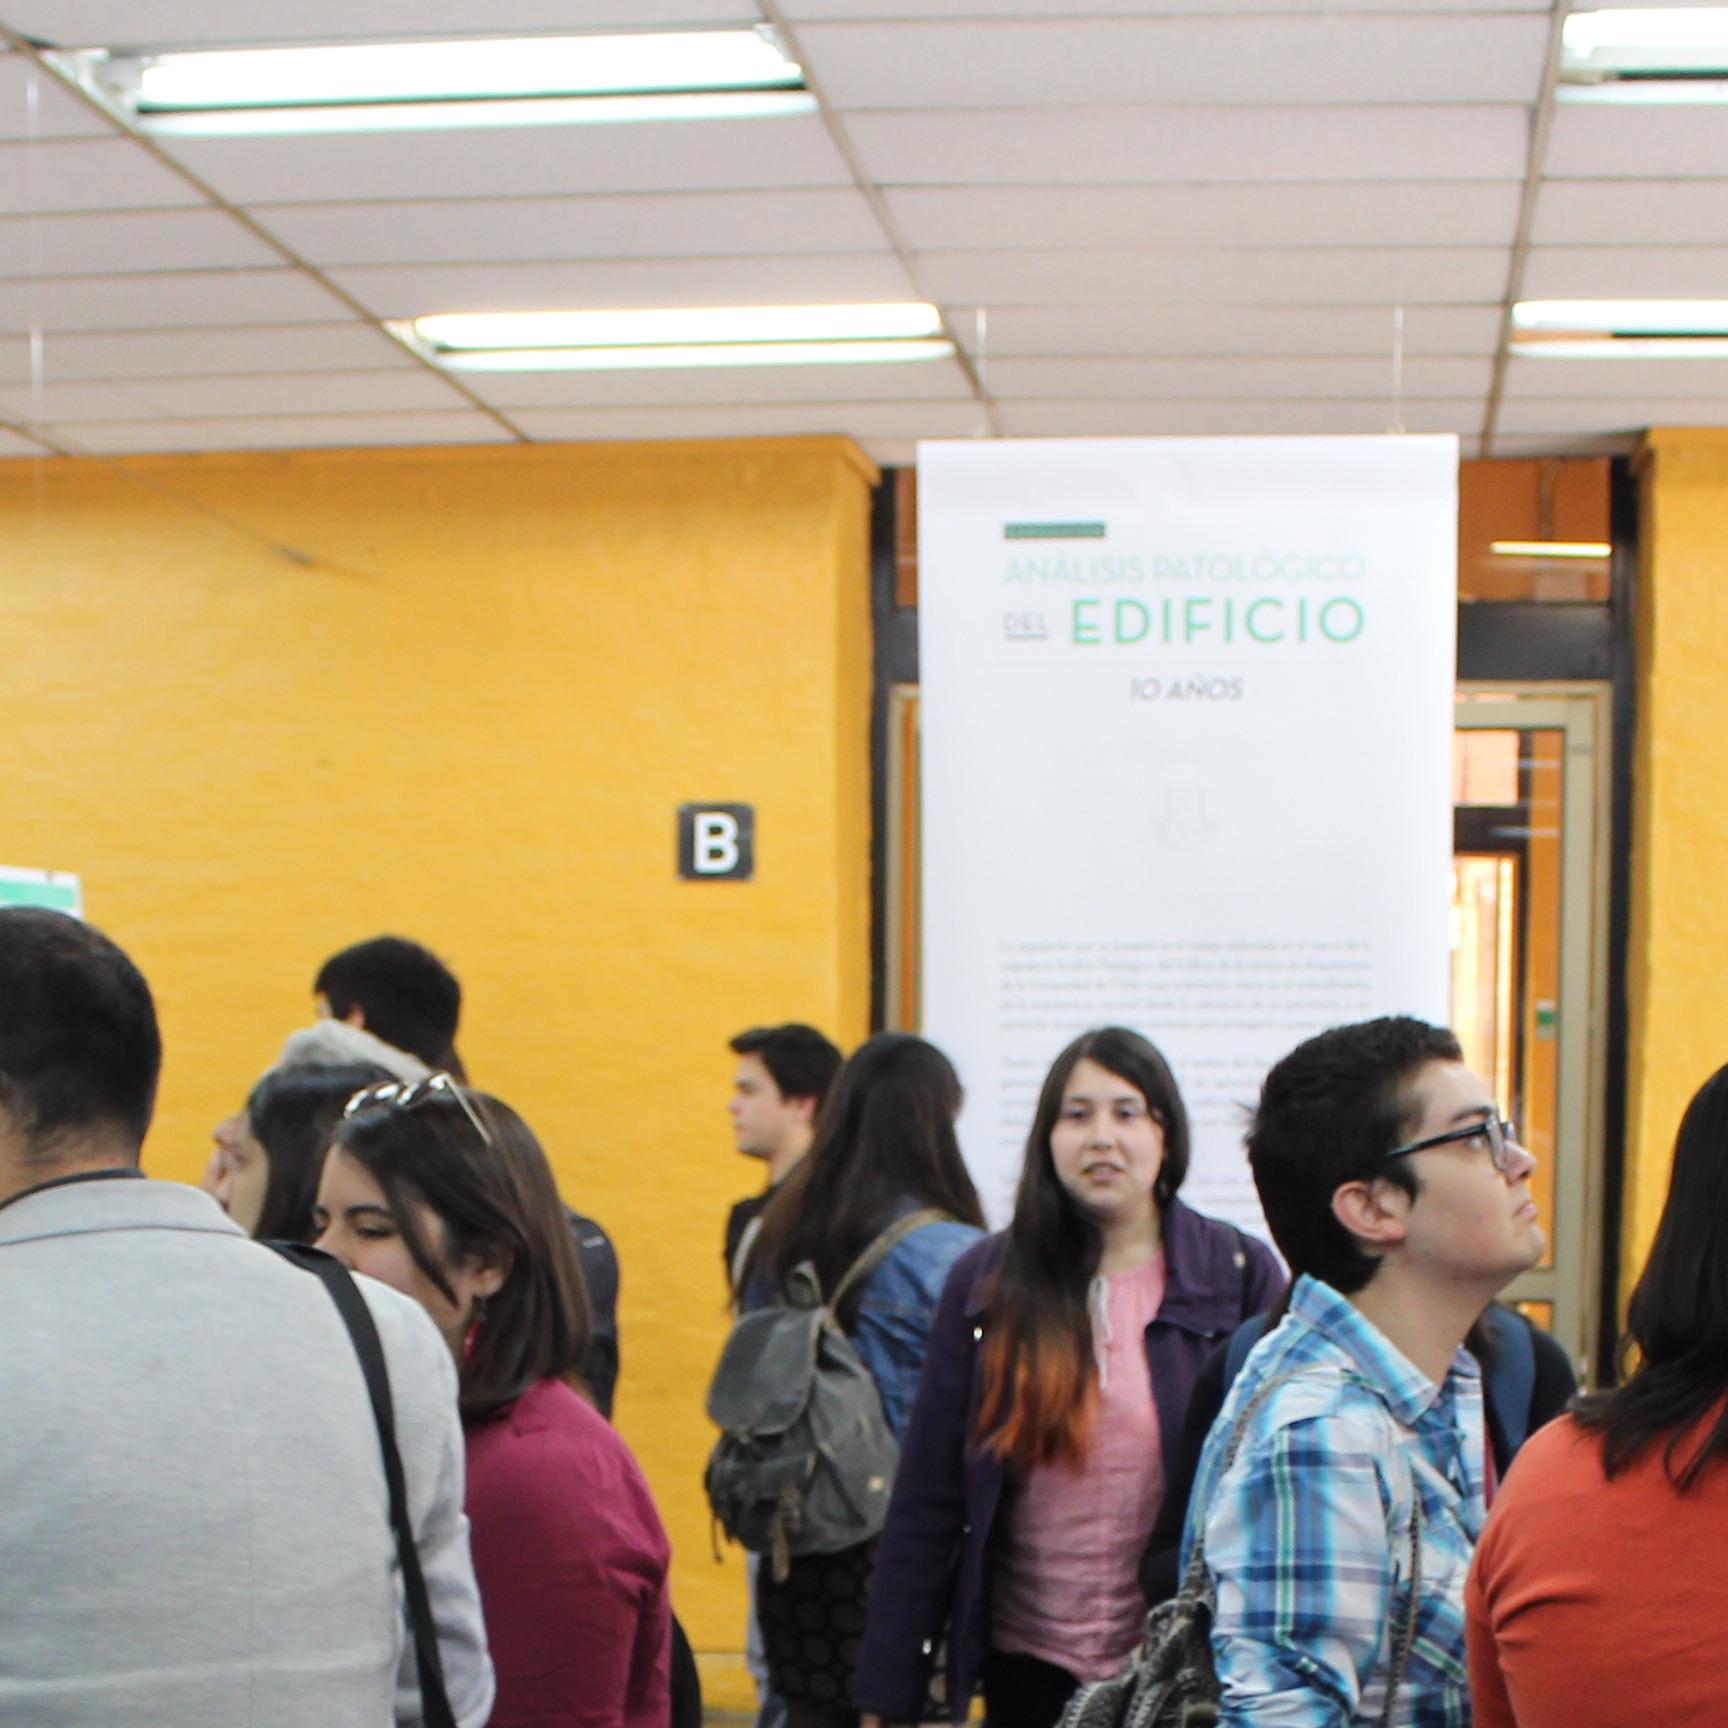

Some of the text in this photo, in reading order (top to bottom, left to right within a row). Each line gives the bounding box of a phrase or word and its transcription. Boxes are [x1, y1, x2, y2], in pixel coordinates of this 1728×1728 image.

[1003, 549, 1366, 585] ANÁLISIS PATOLÓGICO
[1003, 596, 1366, 645] DEL EDIFICIO
[1166, 673, 1244, 702] AÑOS
[694, 810, 739, 874] B
